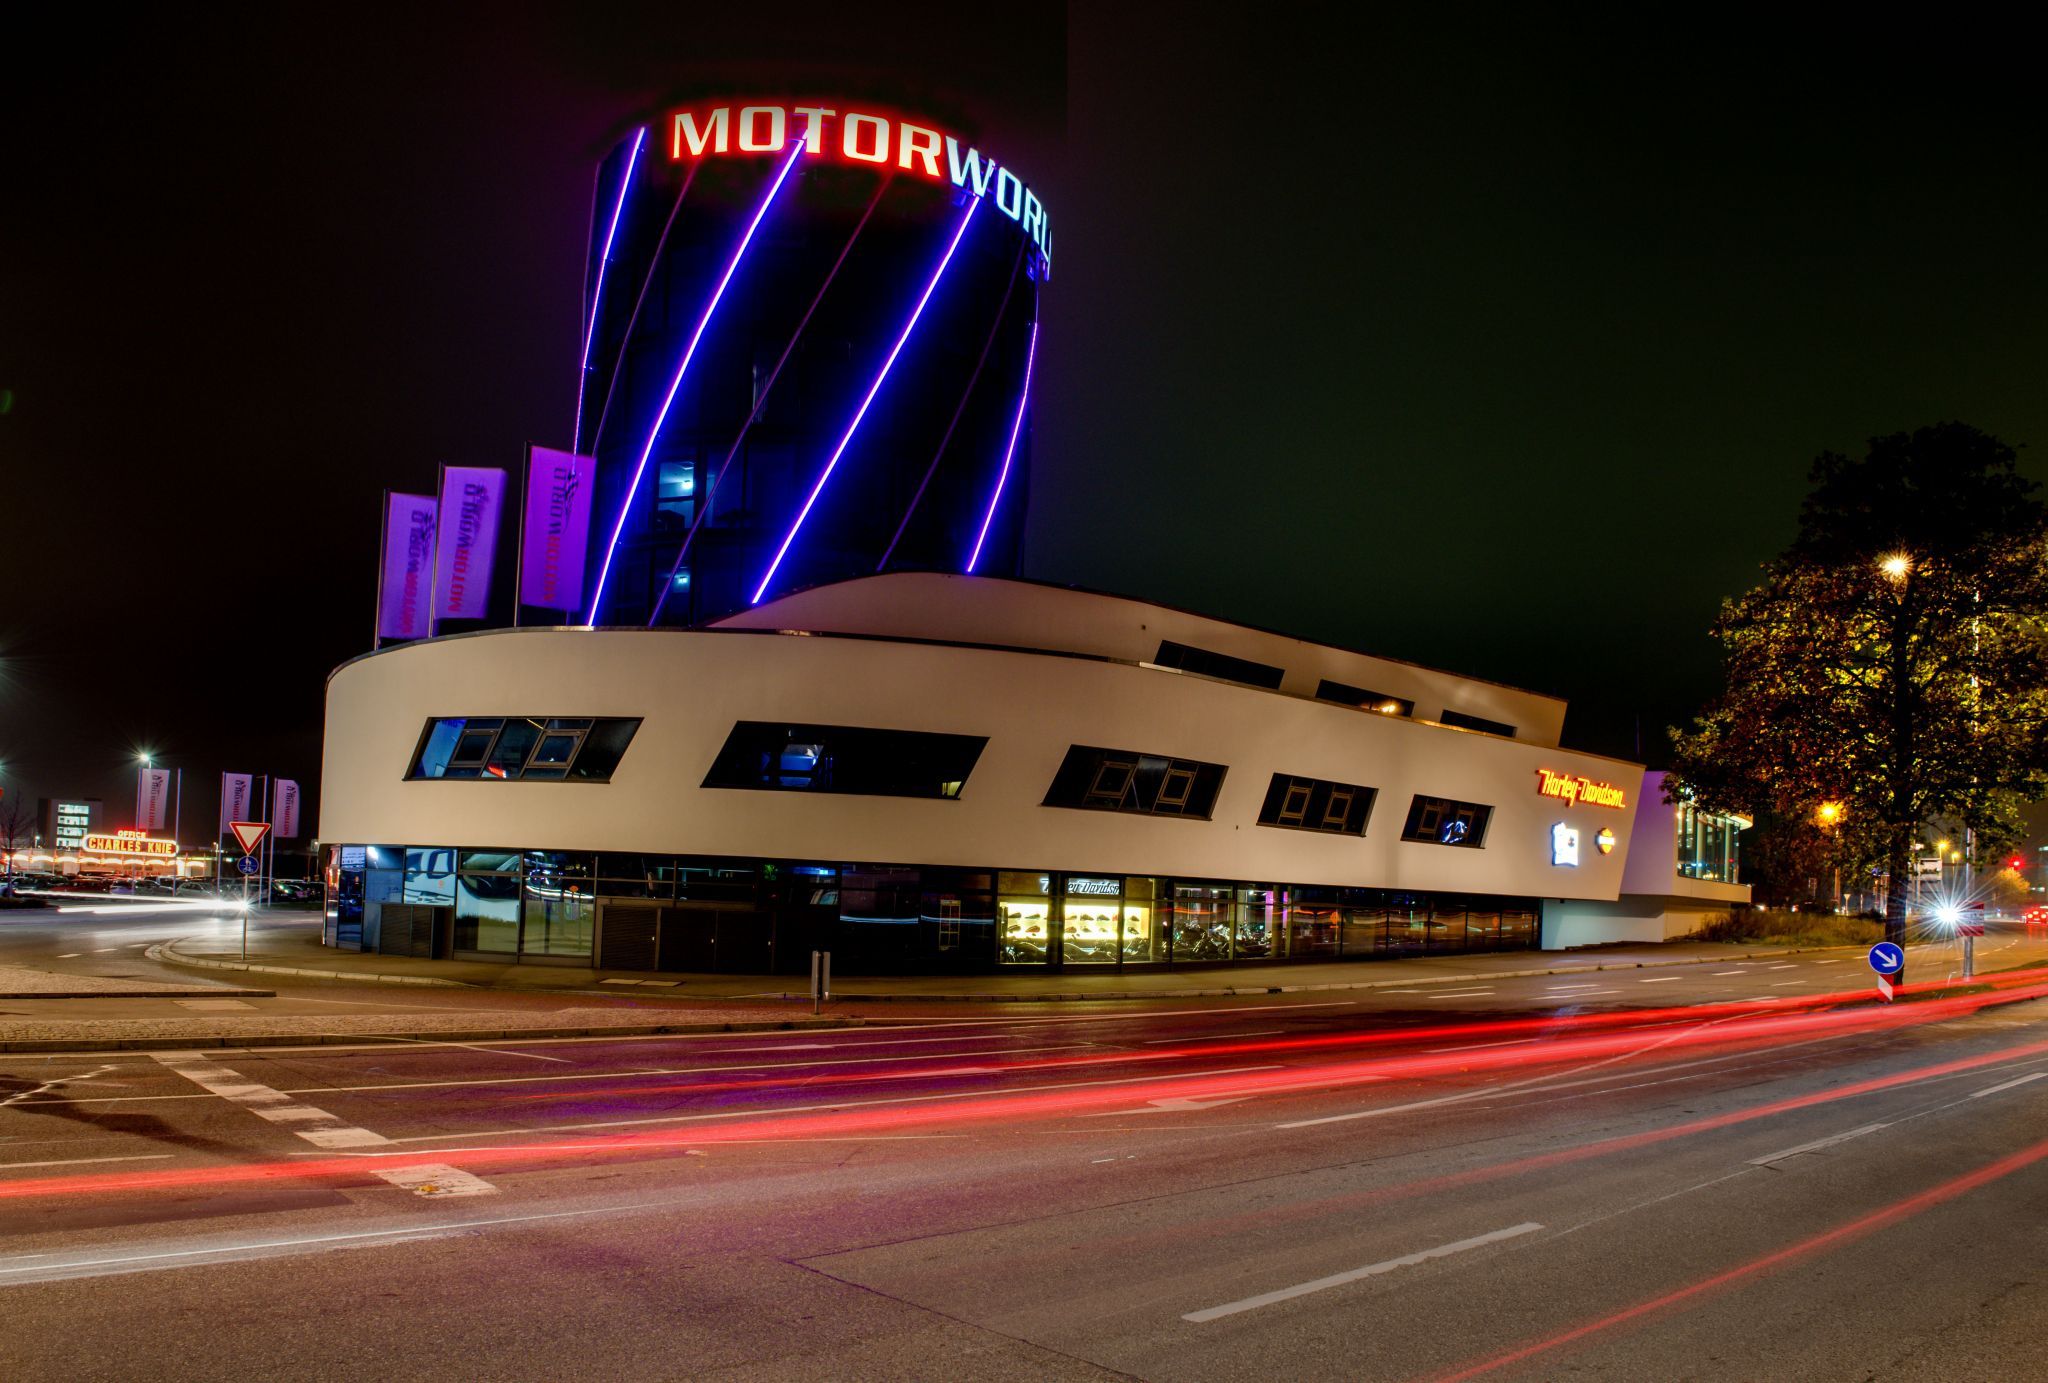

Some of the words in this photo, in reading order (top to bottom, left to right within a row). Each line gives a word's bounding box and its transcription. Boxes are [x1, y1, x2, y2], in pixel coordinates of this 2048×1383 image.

[673, 106, 1052, 266] MOTORWORL
[447, 483, 480, 612] MOTORWORLD
[1538, 769, 1626, 807] Harley-Davidson
[88, 837, 142, 852] CHARLES
[147, 842, 173, 854] KNIE
[118, 830, 147, 839] OFFICE
